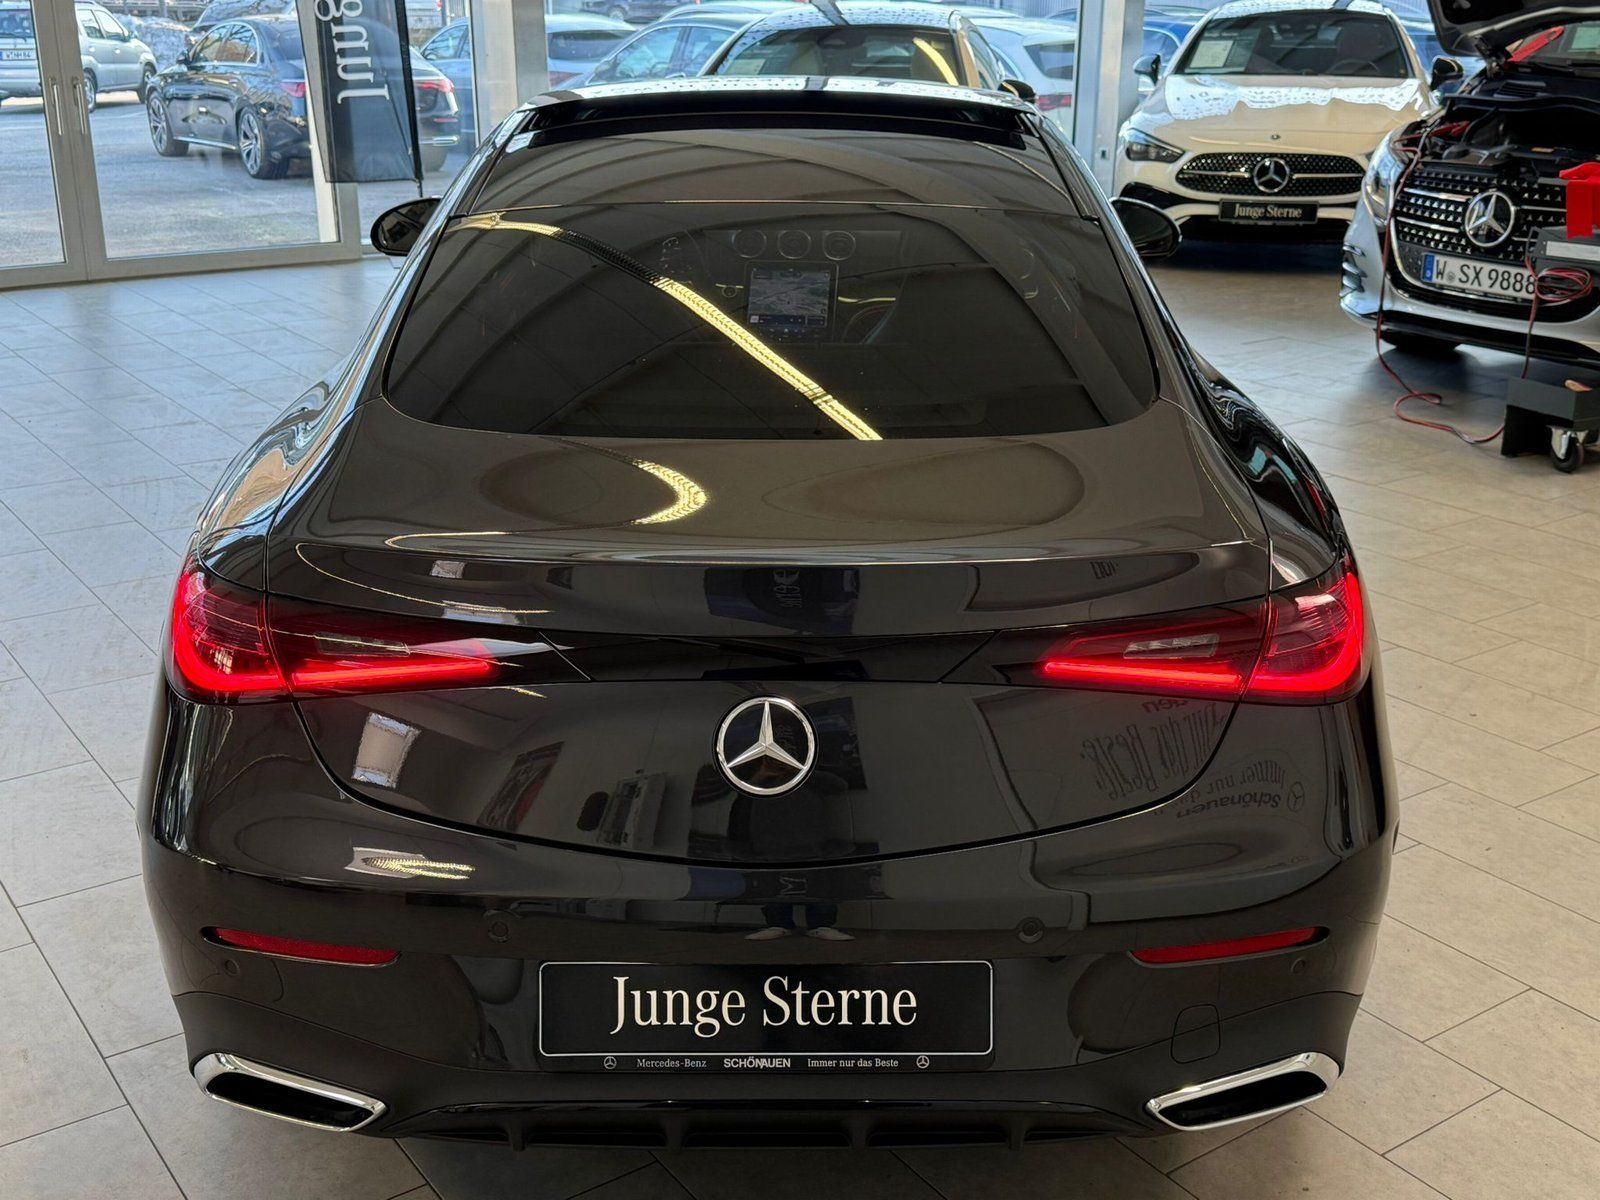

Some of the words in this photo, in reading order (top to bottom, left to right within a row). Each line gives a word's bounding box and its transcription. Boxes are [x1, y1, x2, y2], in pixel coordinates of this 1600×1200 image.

[1233, 203, 1265, 219] Junge
[1266, 204, 1303, 218] Sterne
[1436, 259, 1446, 281] W
[1458, 263, 1484, 288] SX
[1487, 268, 1537, 295] 9888
[610, 976, 746, 1038] Junge
[763, 975, 917, 1027] Sterne
[636, 1058, 707, 1069] Mercedes-Benz
[723, 1056, 791, 1069] SCHÖNAUEN
[807, 1057, 837, 1068] Immer
[839, 1058, 855, 1068] nur
[857, 1057, 873, 1068] das
[875, 1057, 899, 1068] Beste
